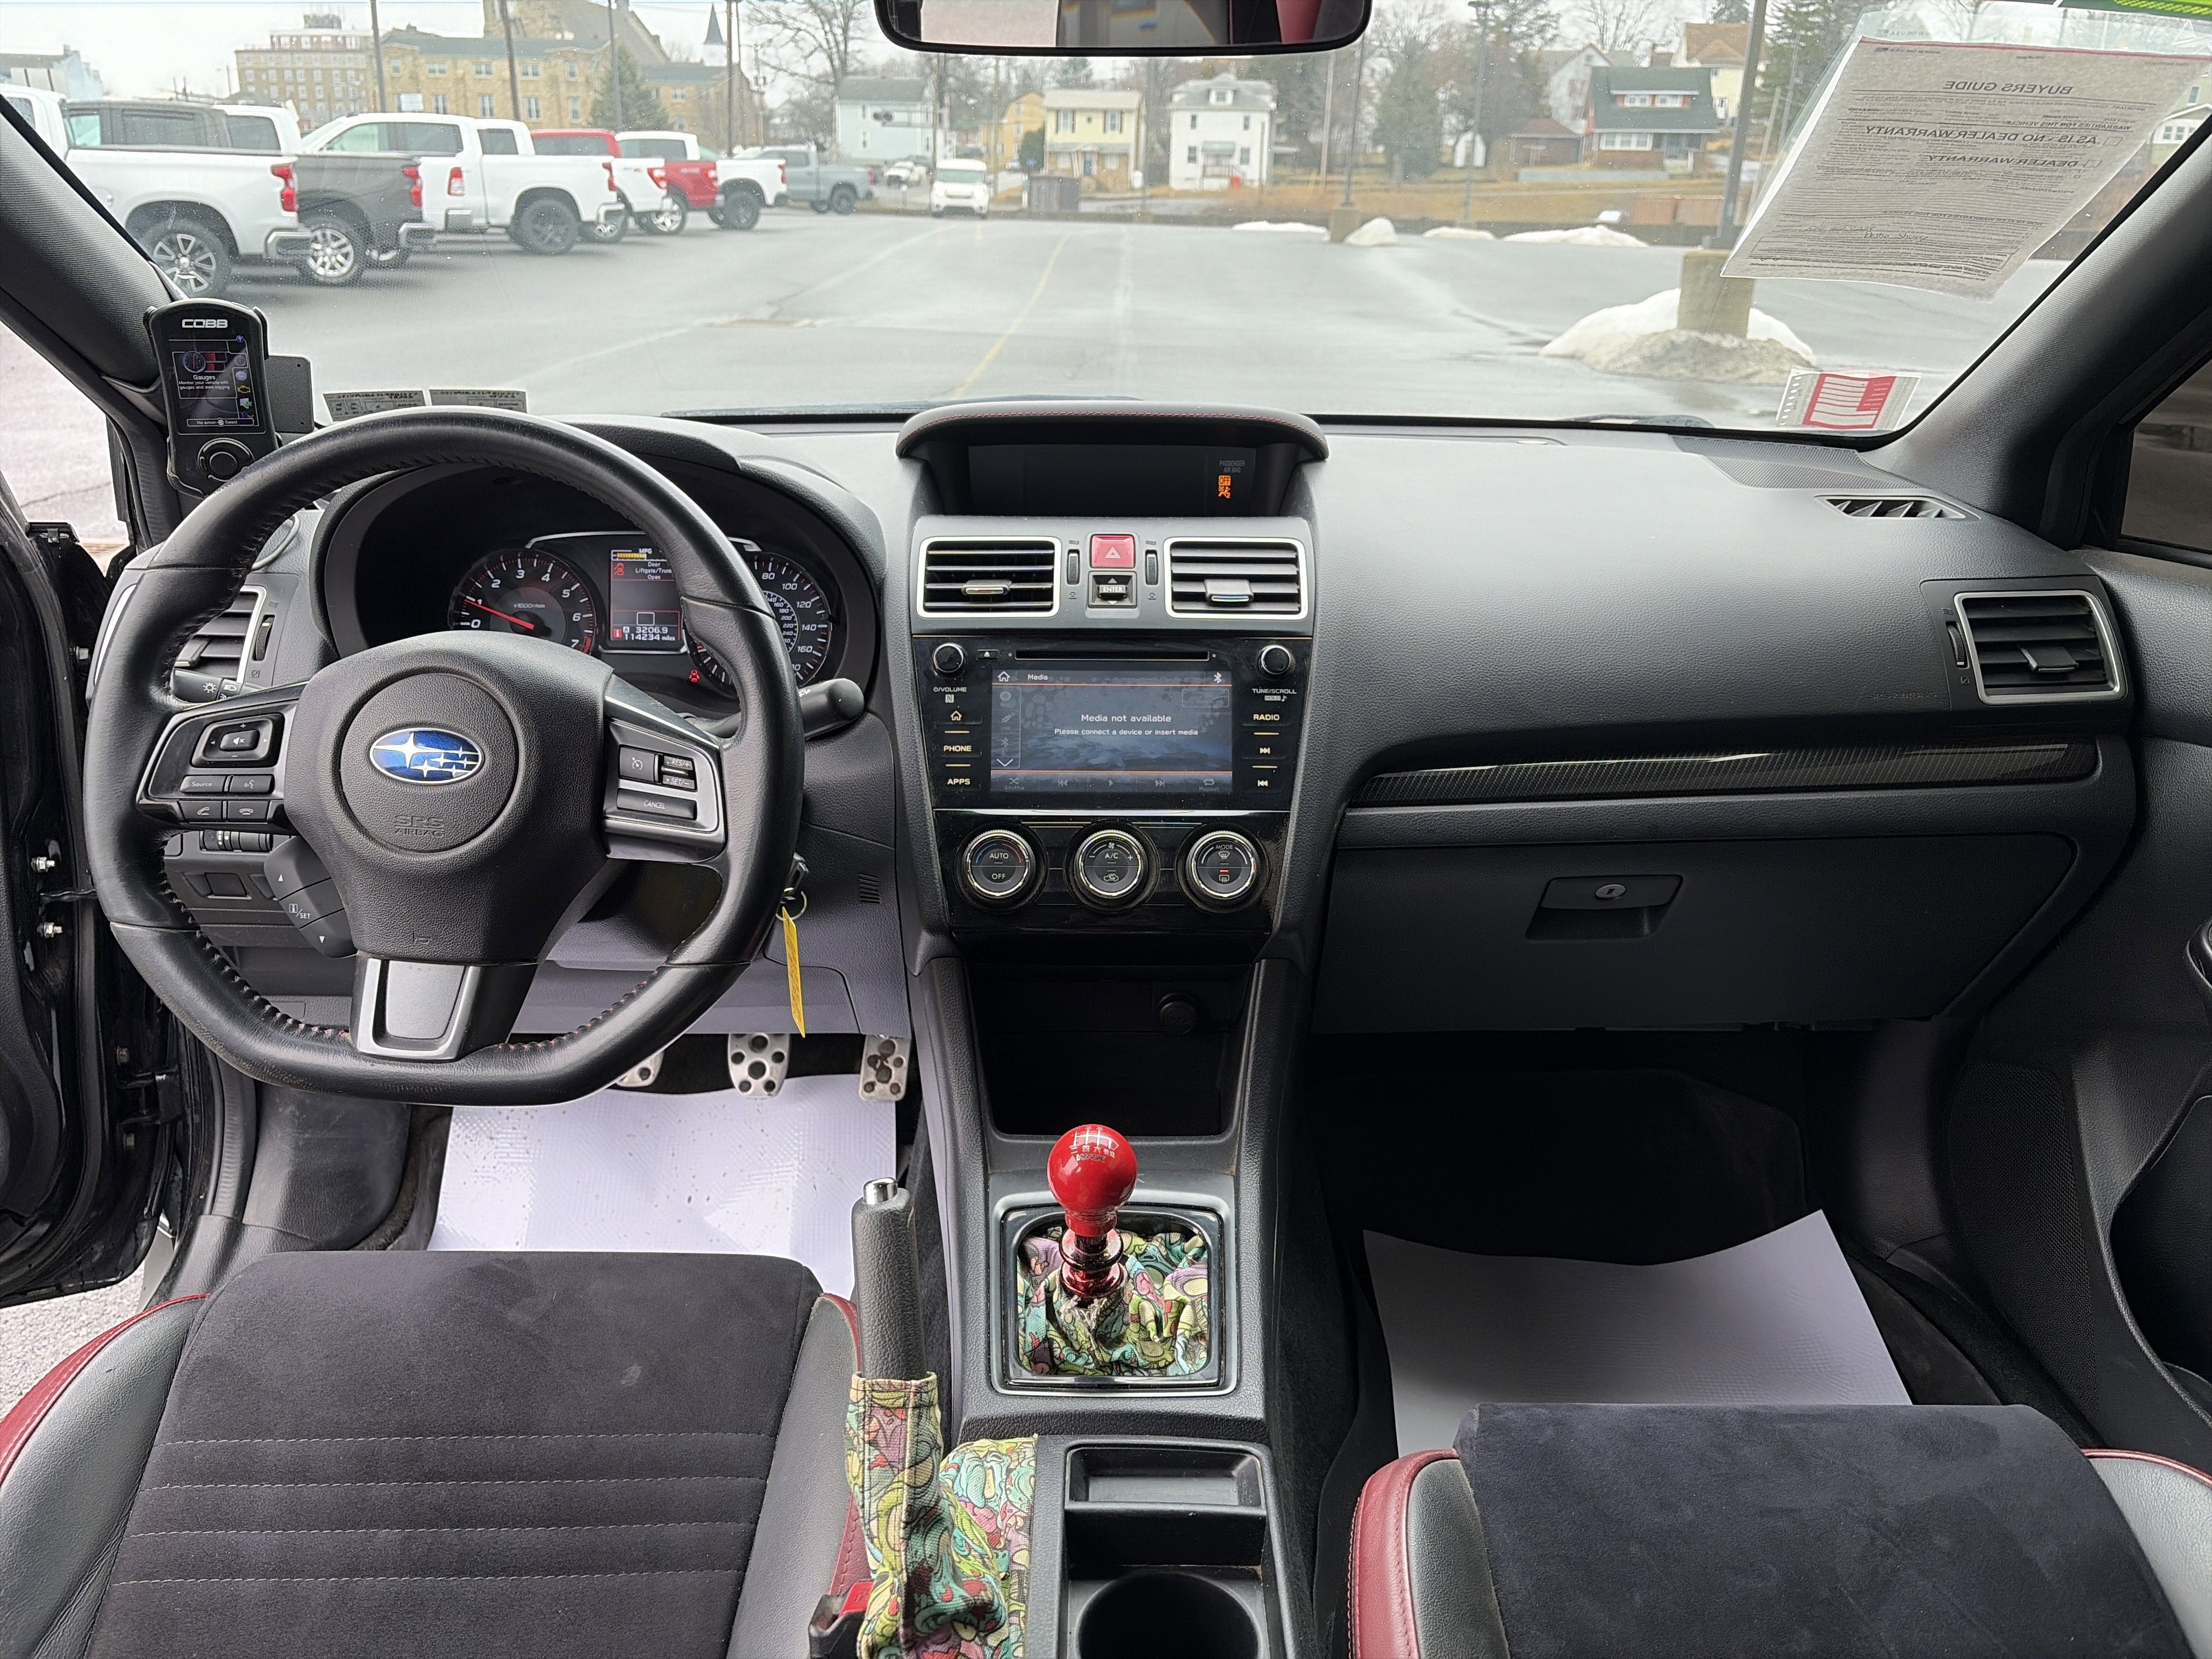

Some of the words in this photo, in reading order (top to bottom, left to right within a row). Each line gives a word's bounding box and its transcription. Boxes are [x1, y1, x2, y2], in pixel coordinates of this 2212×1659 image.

[182, 319, 228, 328] COBB
[1219, 477, 1230, 485] OFF
[516, 569, 525, 579] 3
[541, 573, 550, 582] 4
[761, 572, 775, 580] 80
[491, 579, 501, 588] 2
[561, 589, 571, 598] 5
[572, 612, 582, 622] 6
[470, 619, 481, 628] 0
[571, 639, 579, 648] 7
[797, 645, 813, 653] 160
[1130, 714, 1172, 723] available
[643, 800, 665, 810] CANCEL
[394, 815, 444, 828] SRS
[394, 828, 444, 838] AIRBAG
[1093, 1145, 1102, 1154] 六
